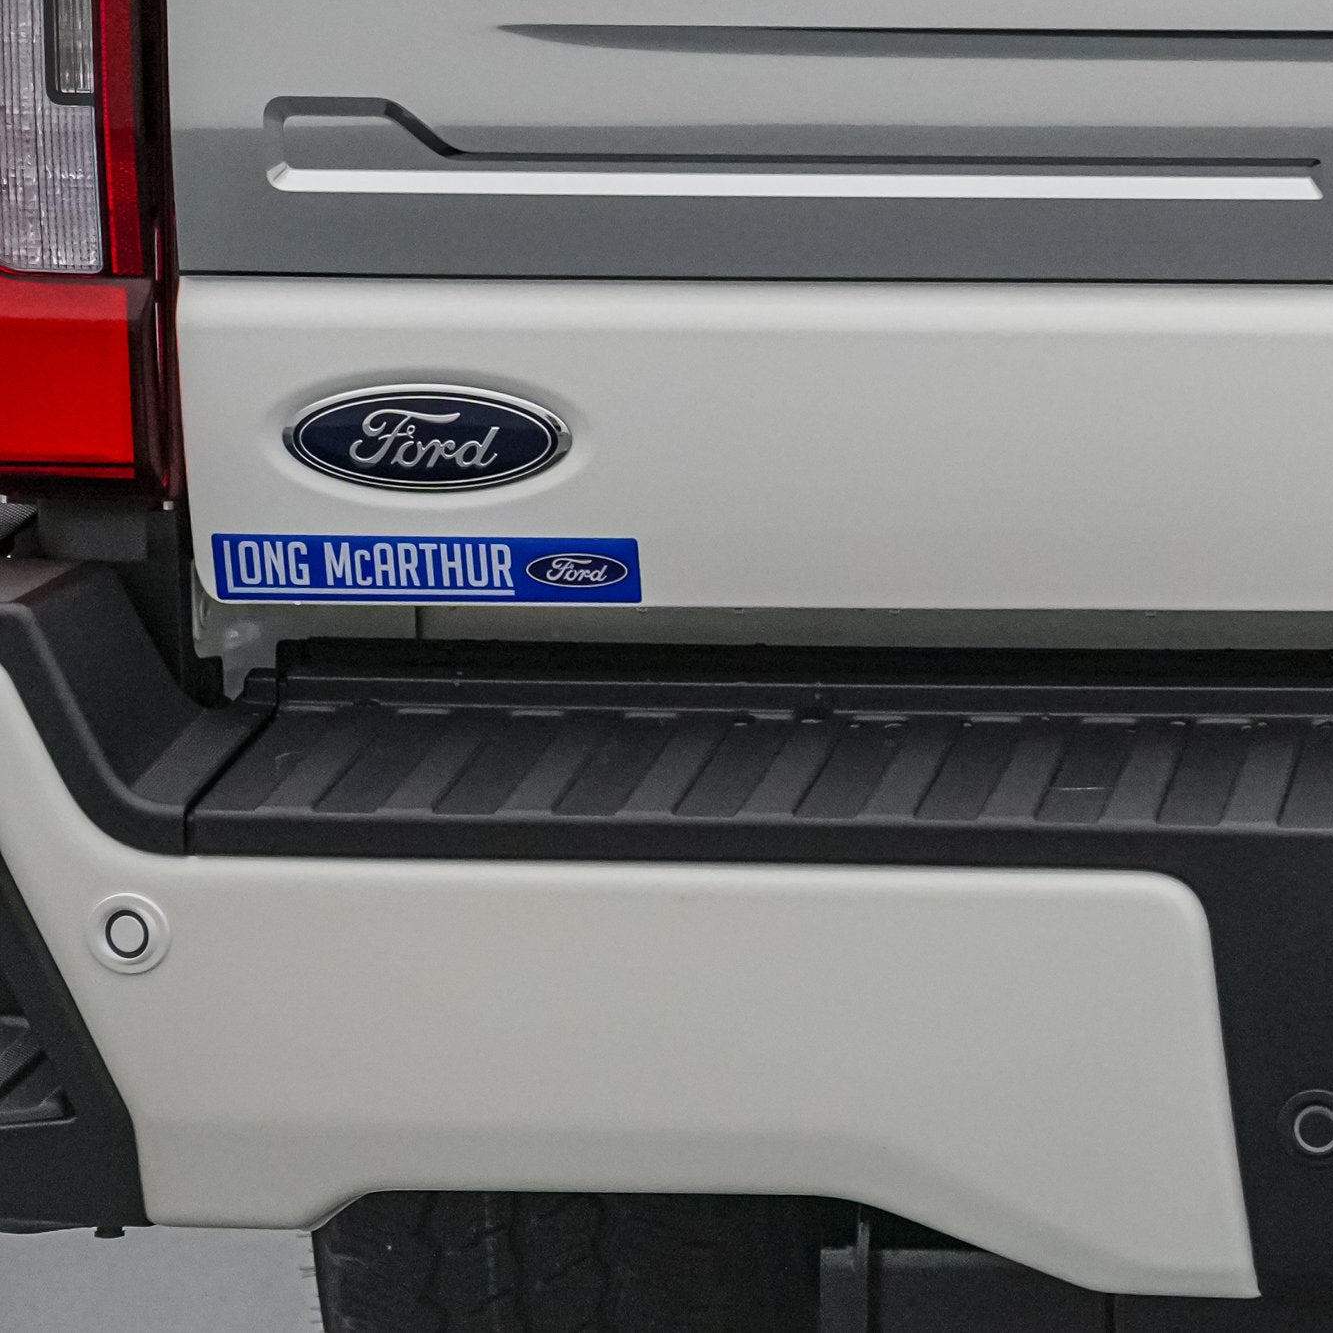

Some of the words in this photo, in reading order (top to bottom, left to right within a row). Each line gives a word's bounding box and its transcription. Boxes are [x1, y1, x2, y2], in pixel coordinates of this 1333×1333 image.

[348, 408, 500, 468] Ford
[222, 539, 311, 593] LONG
[322, 541, 516, 588] McARTHUR
[545, 557, 607, 583] Ford
